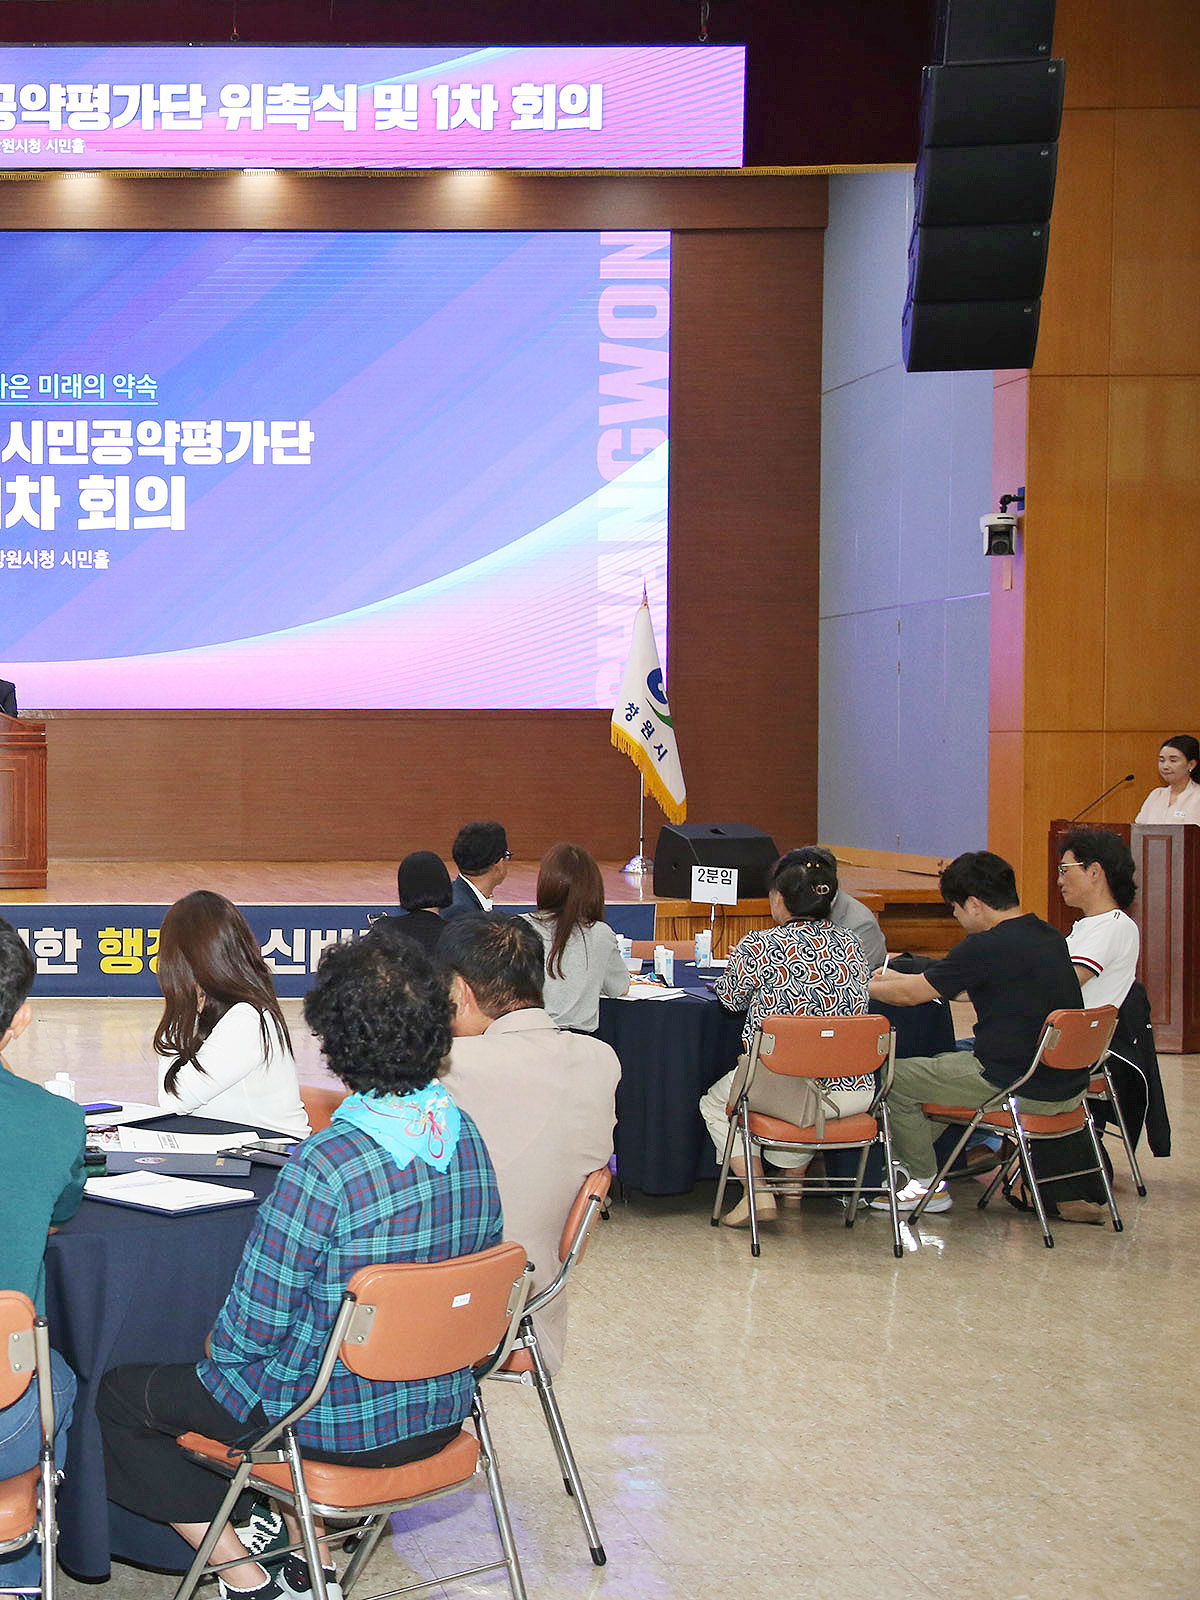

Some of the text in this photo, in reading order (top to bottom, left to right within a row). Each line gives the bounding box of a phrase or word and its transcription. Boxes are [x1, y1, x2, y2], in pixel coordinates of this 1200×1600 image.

[218, 83, 359, 132] 위촉식
[374, 83, 418, 132] 및
[431, 83, 497, 132] 1차
[510, 83, 603, 132] 회의
[46, 138, 86, 154] 시민홀
[38, 372, 107, 400] 미래의
[112, 373, 161, 400] 약속
[1, 418, 315, 466] 시민공약평가단
[77, 474, 187, 532] 회의
[59, 549, 111, 570] 시민홀
[624, 702, 668, 762] 창원시
[697, 867, 733, 886] 2분임
[17, 927, 82, 975] 한
